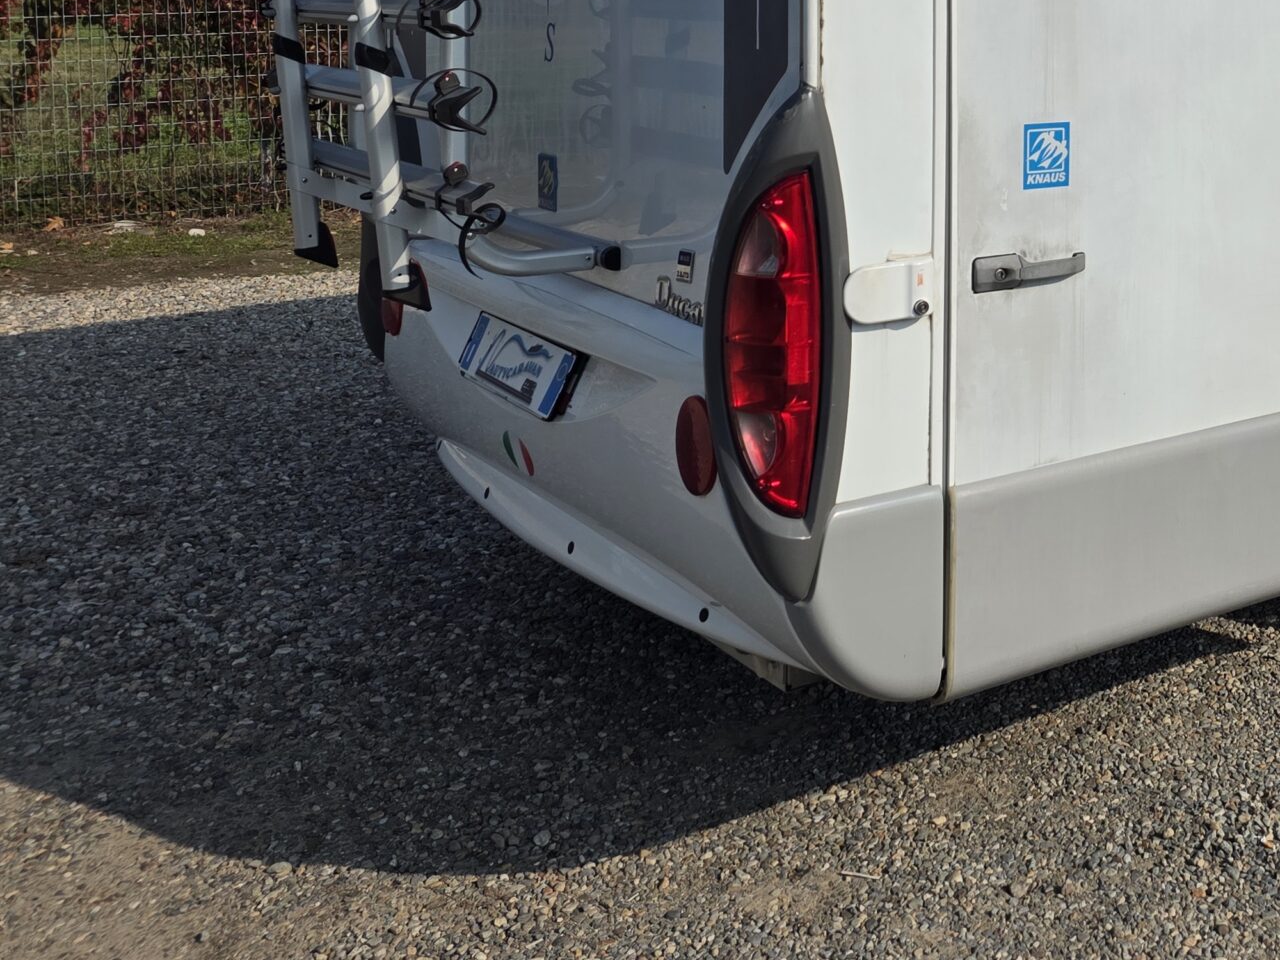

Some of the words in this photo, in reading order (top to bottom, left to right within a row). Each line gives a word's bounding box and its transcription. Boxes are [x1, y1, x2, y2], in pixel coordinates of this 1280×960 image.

[543, 22, 556, 62] S
[1026, 172, 1067, 185] KNAUS
[655, 274, 705, 328] Duca
